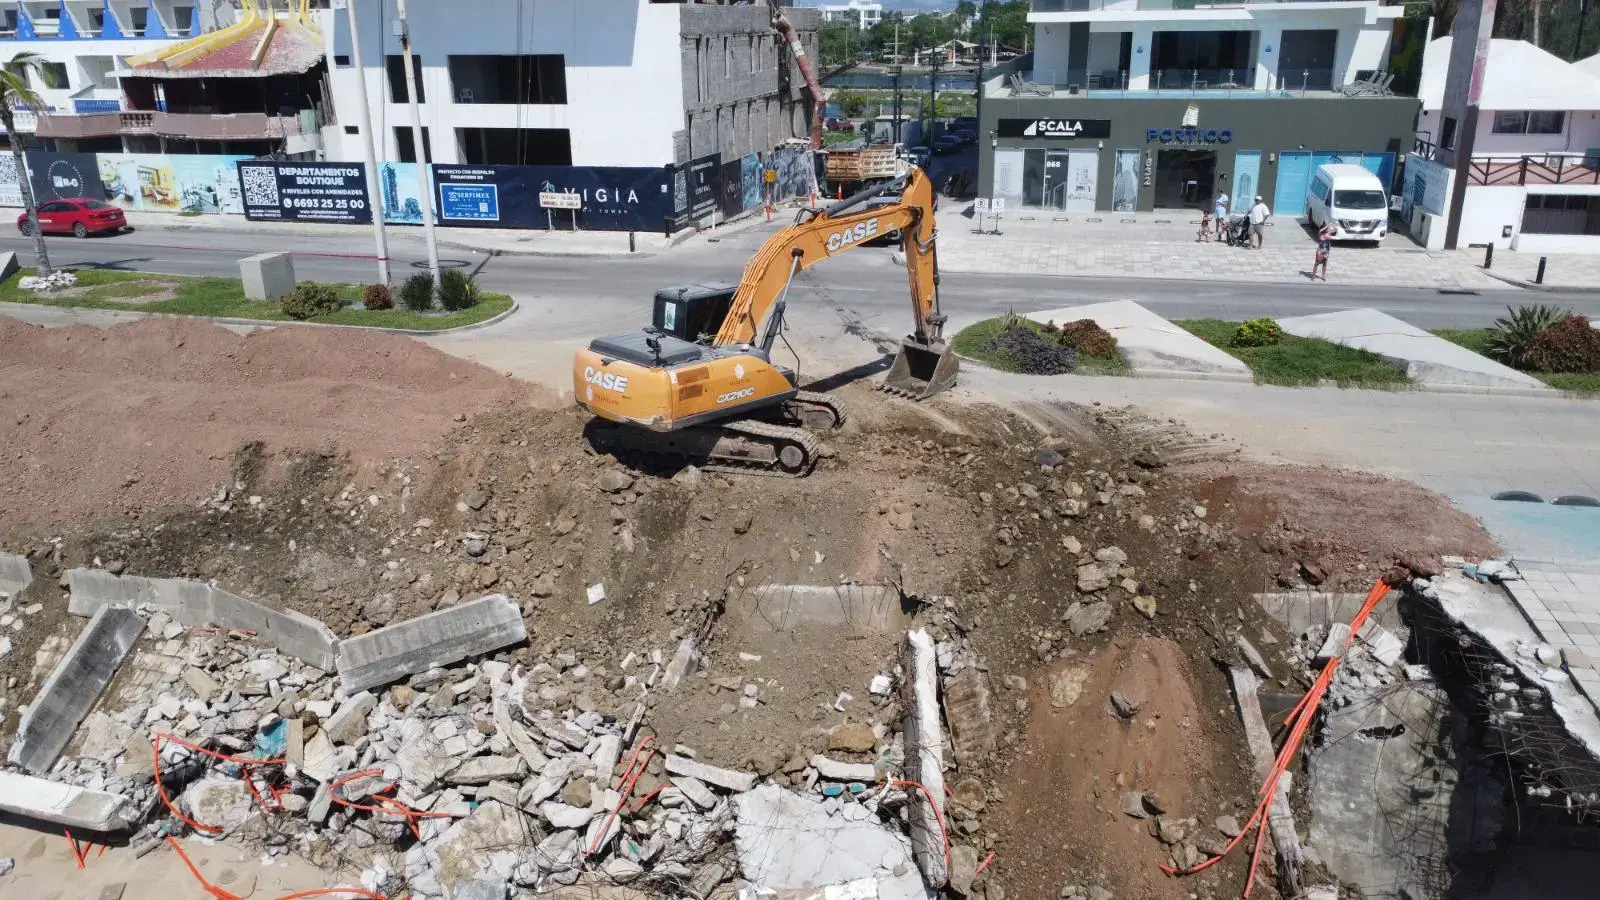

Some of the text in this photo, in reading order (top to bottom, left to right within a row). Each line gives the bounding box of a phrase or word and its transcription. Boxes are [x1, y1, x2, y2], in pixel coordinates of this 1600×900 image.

[1039, 121, 1082, 131] SCALA
[279, 167, 359, 177] DEPARTAMENTOS
[296, 177, 344, 185] BOUTIQUE
[294, 198, 364, 208] 6693 25 25 00
[827, 217, 878, 252] CASE
[584, 365, 629, 393] CASE
[716, 387, 755, 404] CX210C
